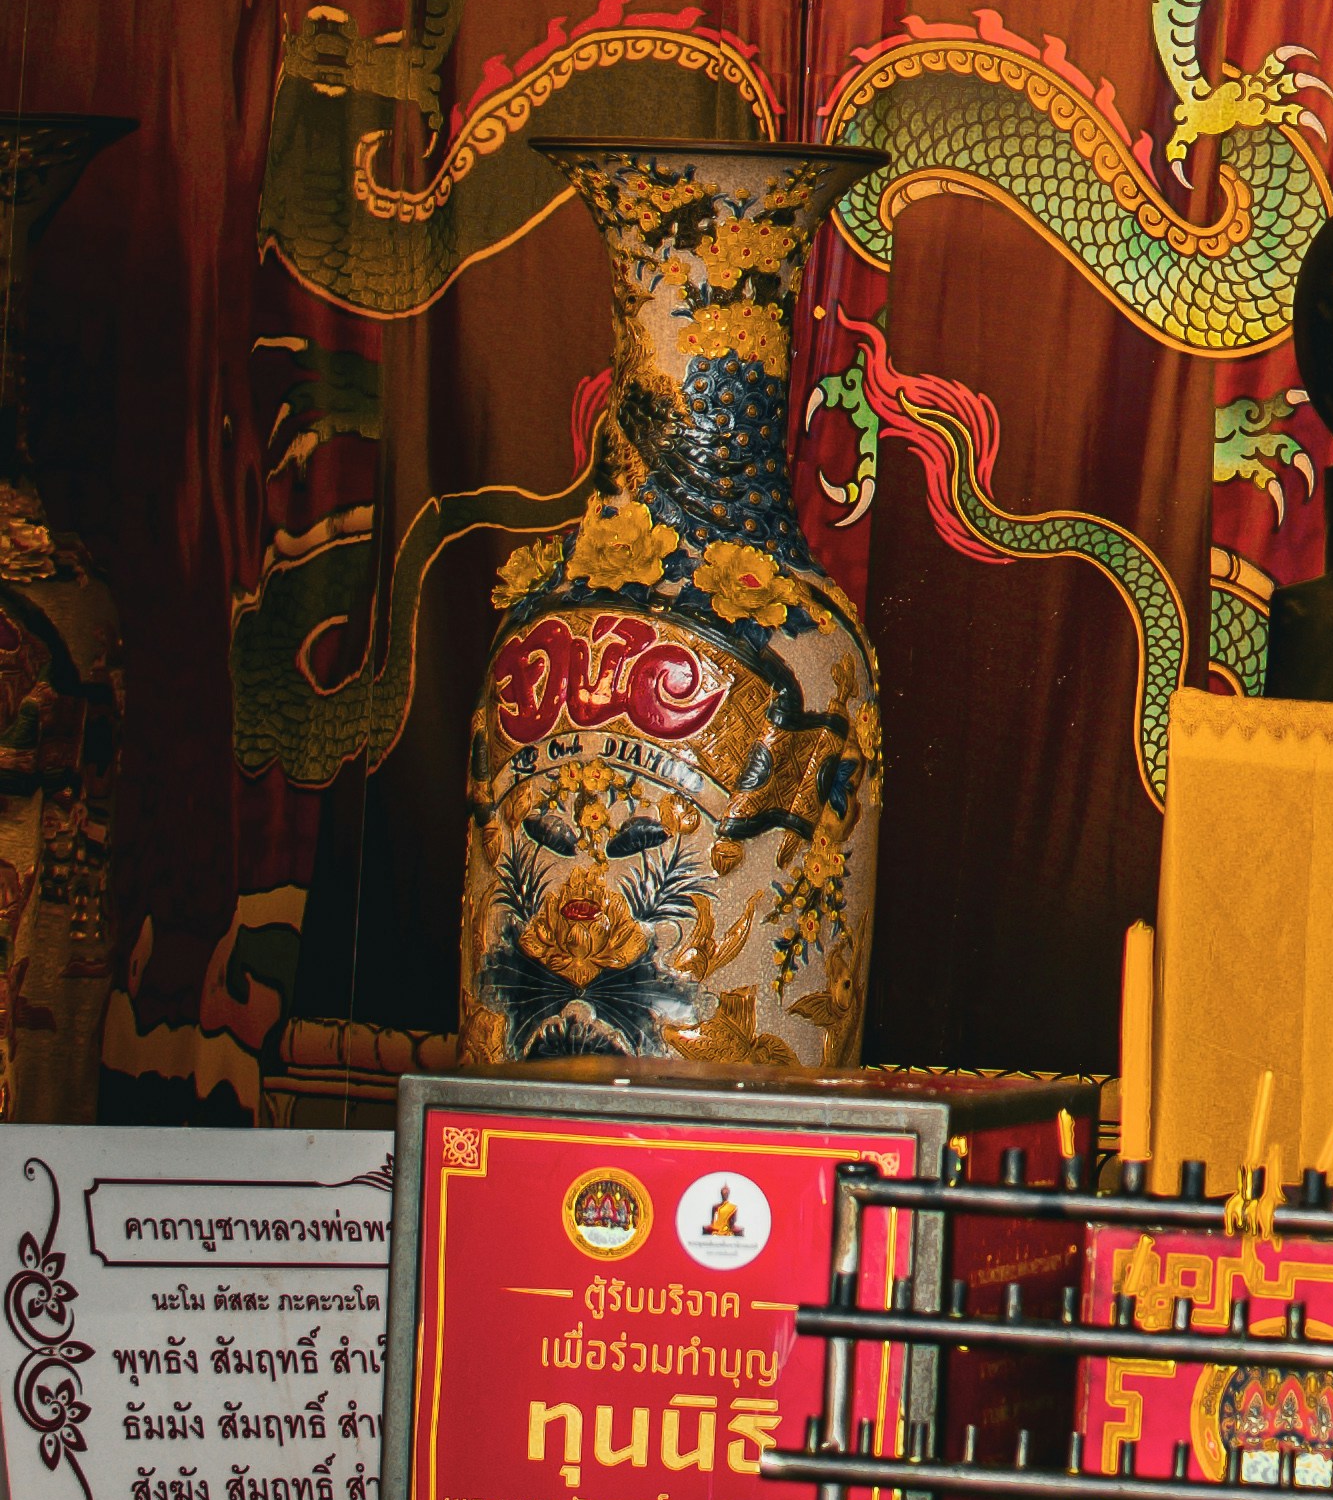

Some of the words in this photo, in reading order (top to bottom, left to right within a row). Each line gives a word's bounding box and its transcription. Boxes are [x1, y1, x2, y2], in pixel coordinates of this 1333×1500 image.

[125, 1208, 392, 1252] คาถาบูชาหลวงพ่อพ
[152, 1283, 205, 1311] นะโม
[214, 1284, 269, 1311] ตัสสะ
[584, 1274, 741, 1319] ตู้รับบริจาค
[113, 1335, 199, 1387] พุทธัง
[210, 1325, 321, 1382] สัมฤทธิ์
[541, 1321, 779, 1387] เพื่อร่วมทำบุญ
[123, 1401, 205, 1439] ธัมมัง
[217, 1390, 329, 1446] สัมฤทธิ์
